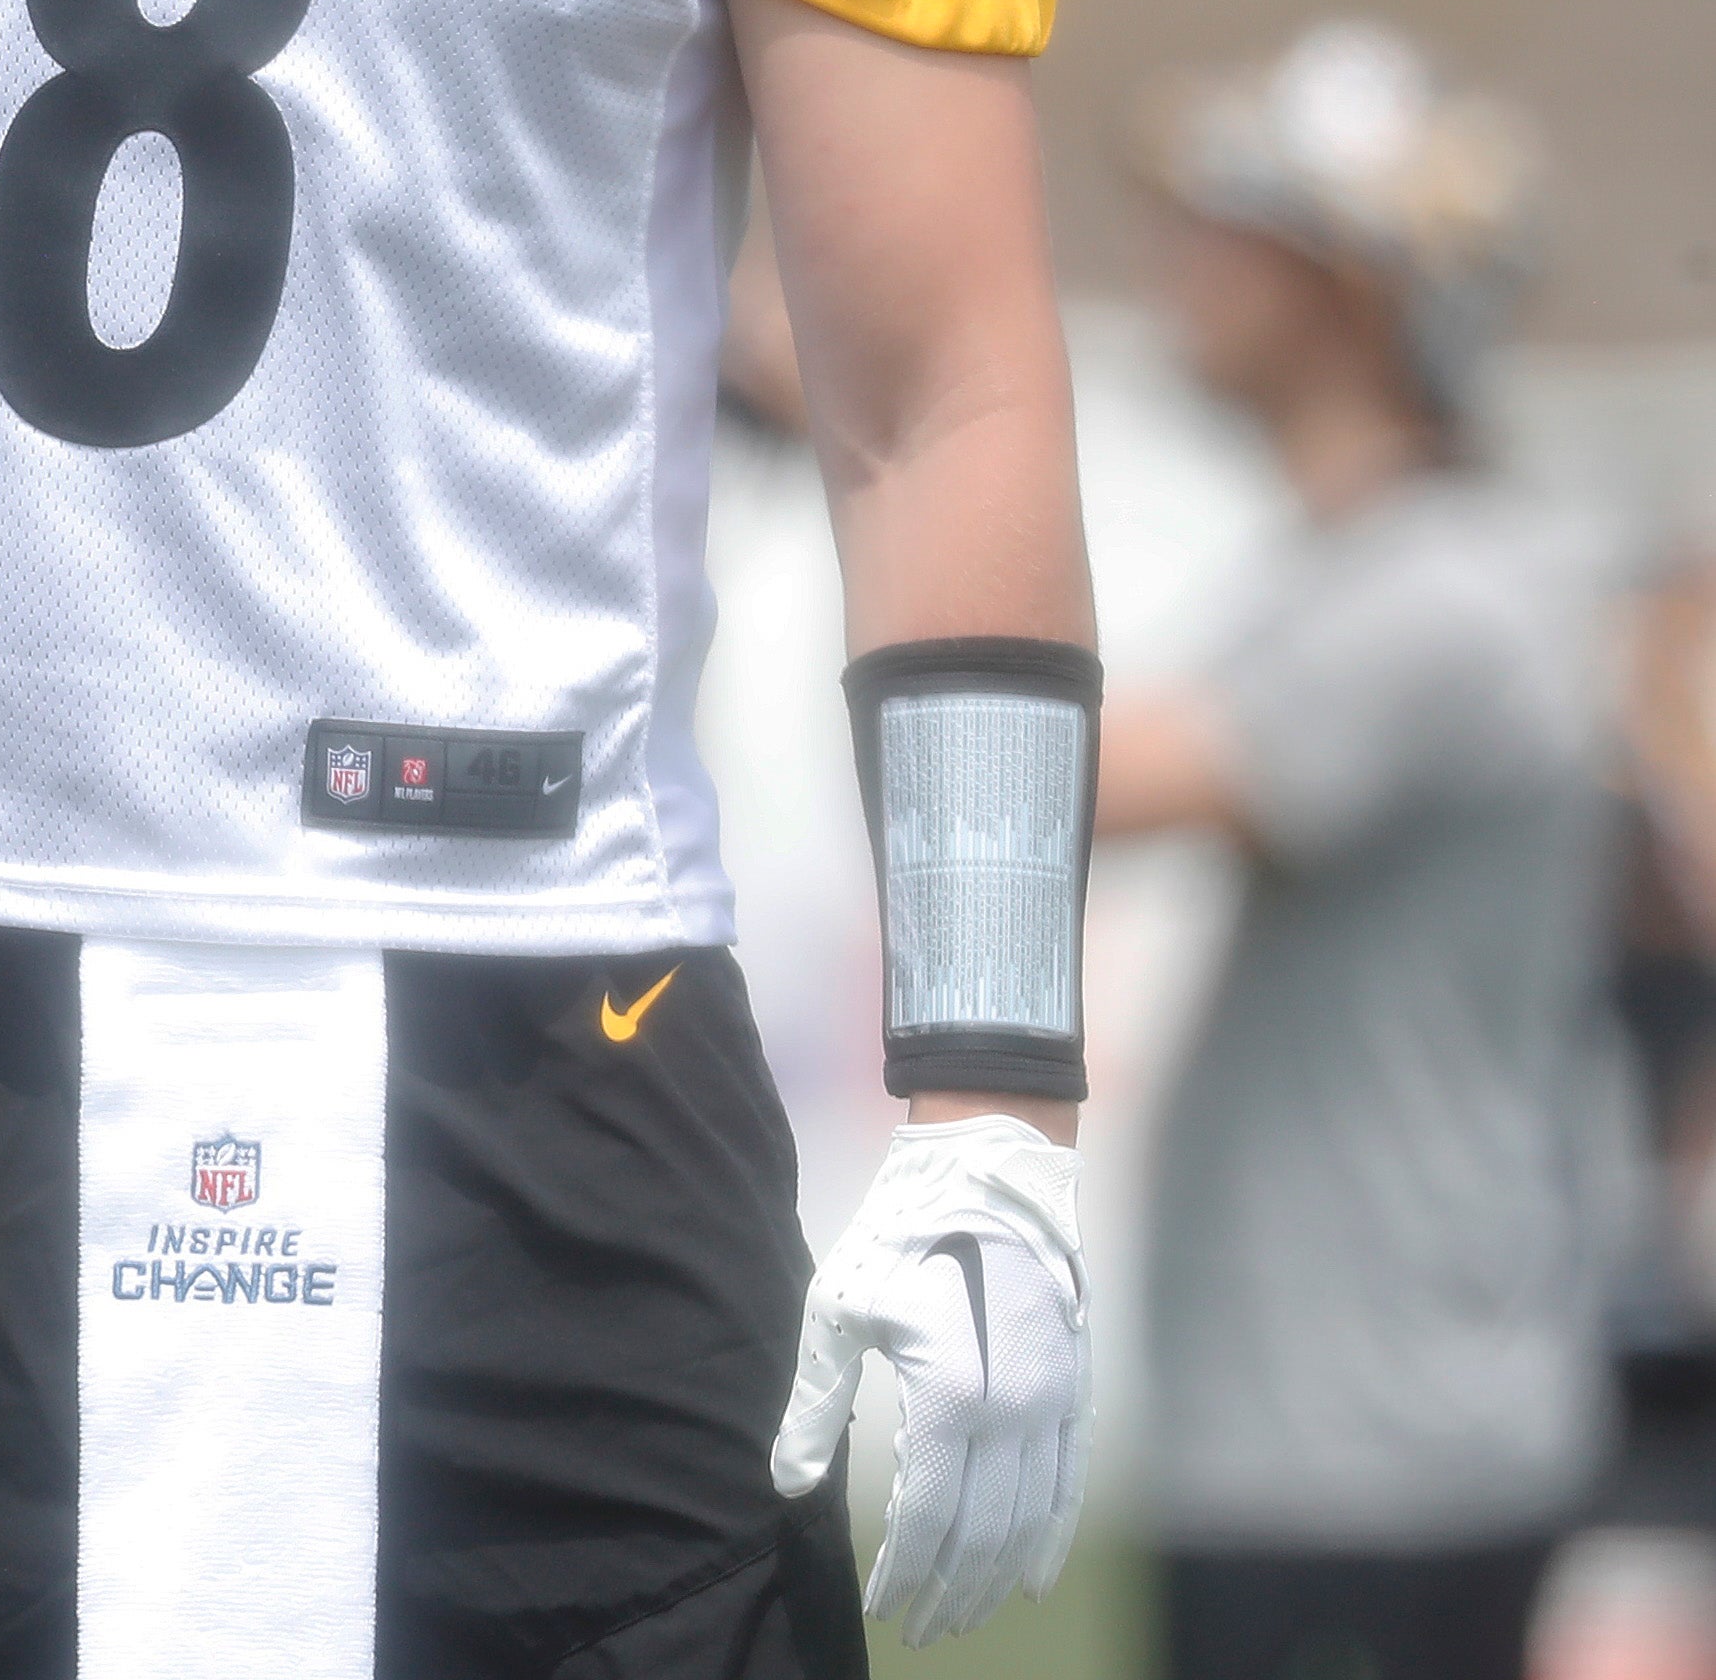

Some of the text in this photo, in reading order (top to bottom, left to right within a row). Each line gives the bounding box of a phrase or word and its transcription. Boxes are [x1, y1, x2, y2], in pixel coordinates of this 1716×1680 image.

[331, 770, 364, 797] NFL
[198, 1169, 253, 1206] NFL
[147, 1224, 303, 1256] INSPIRE
[112, 1260, 338, 1305] CHANGE
